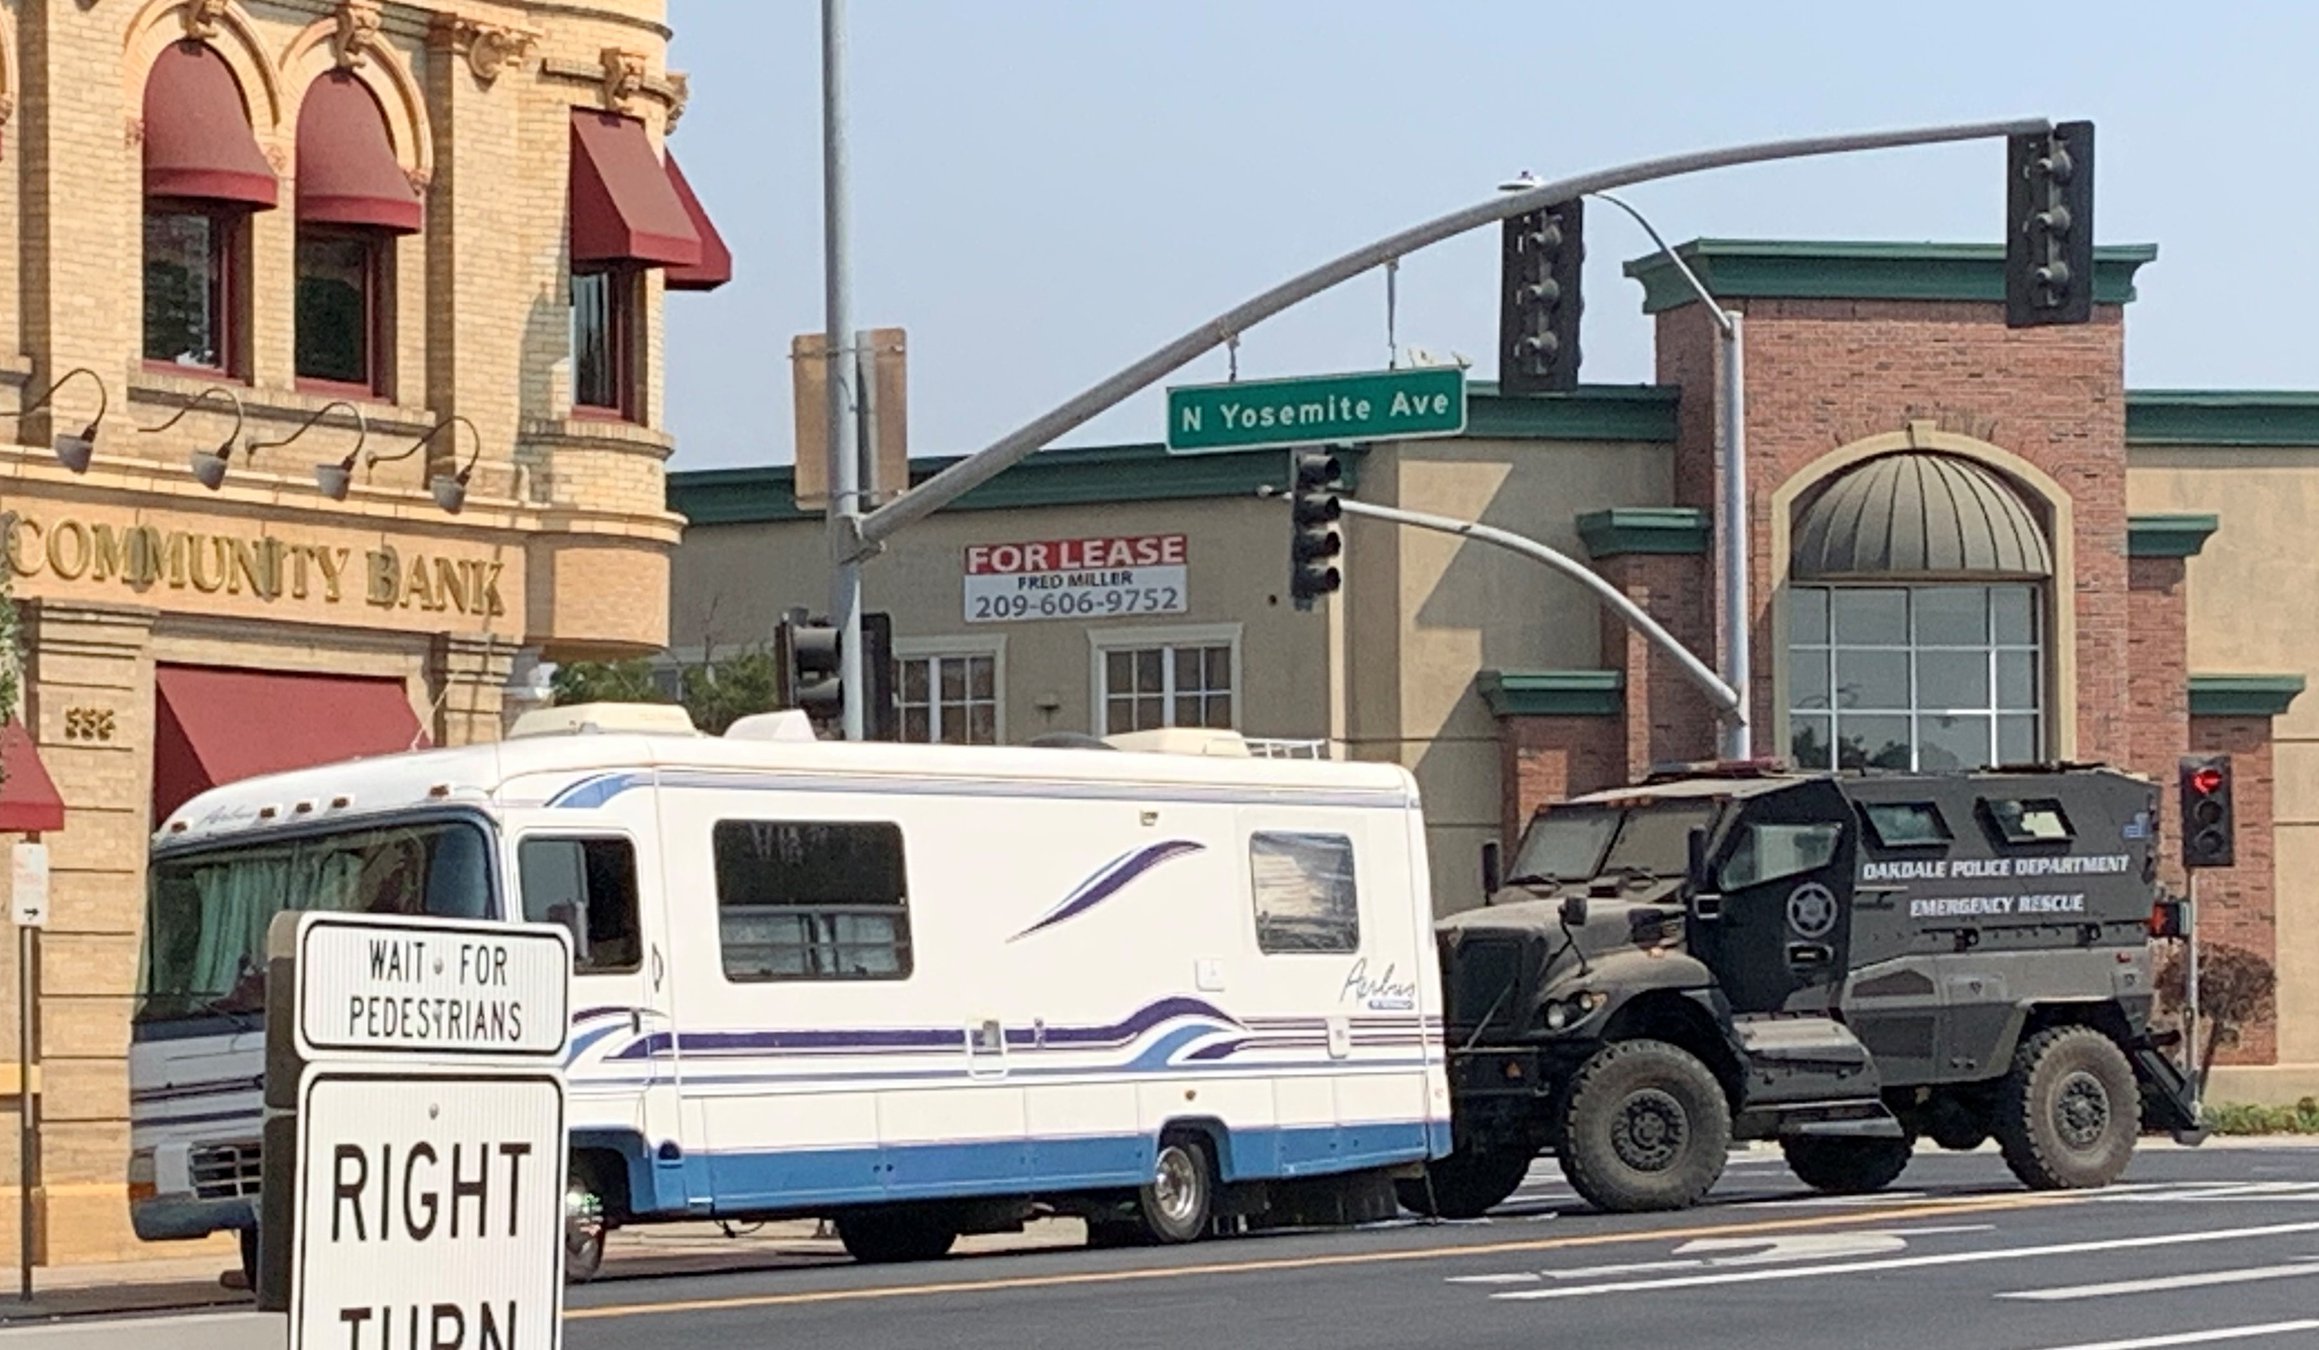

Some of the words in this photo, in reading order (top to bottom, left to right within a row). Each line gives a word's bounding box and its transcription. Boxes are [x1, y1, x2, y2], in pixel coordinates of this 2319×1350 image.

[1182, 406, 1201, 432] N
[1220, 395, 1371, 429] Yosemite
[1390, 391, 1449, 417] Ave
[5, 518, 350, 601] COMMUNITY
[366, 550, 506, 616] BANK
[968, 543, 1048, 574] FOR
[1059, 536, 1184, 569] LEASE
[1018, 574, 1063, 591] FRED
[1068, 570, 1133, 587] MILLER
[976, 586, 1178, 619] 209-606-9752
[1863, 861, 1946, 880] OAKDALE
[1951, 858, 2011, 878] POLICE
[2015, 854, 2130, 876] DEPARTMENT
[1910, 896, 2013, 917] EMERGENCY
[2018, 893, 2084, 913] RESCUE
[369, 939, 425, 983] WAIT
[460, 944, 507, 986] FOR
[349, 996, 523, 1041] PEDESTRIANS
[331, 1140, 532, 1243] RIGHT
